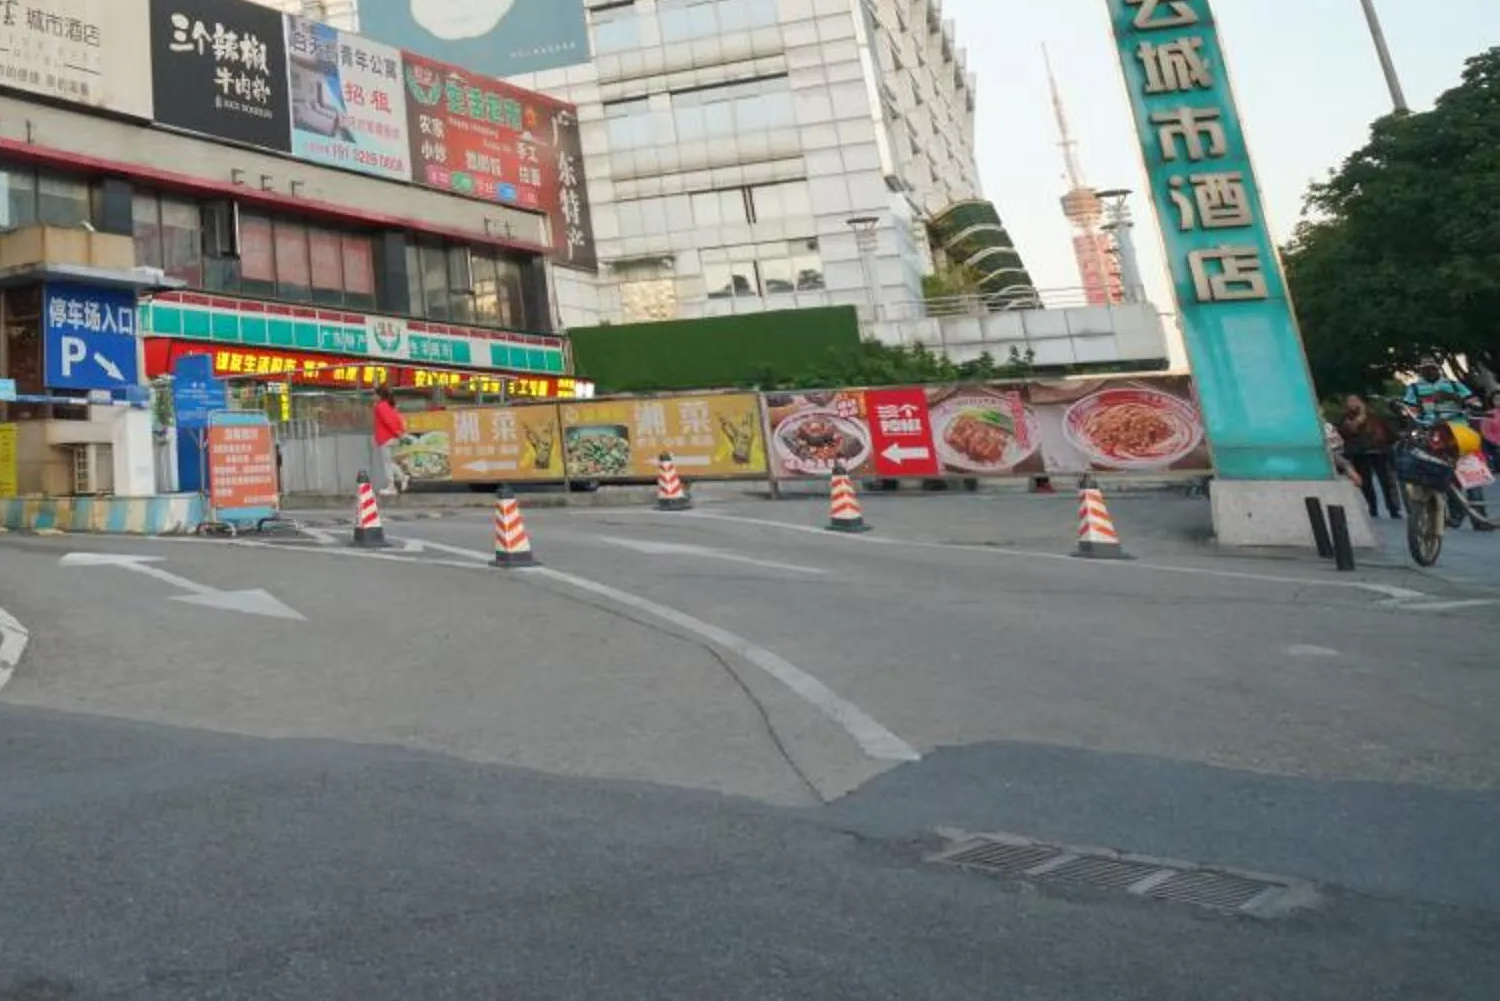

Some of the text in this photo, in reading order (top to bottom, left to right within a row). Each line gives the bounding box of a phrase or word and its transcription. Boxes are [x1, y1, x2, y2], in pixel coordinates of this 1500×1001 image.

[169, 13, 270, 76] 三个辣椒
[49, 296, 133, 336] 停车场入口
[61, 335, 87, 377] P
